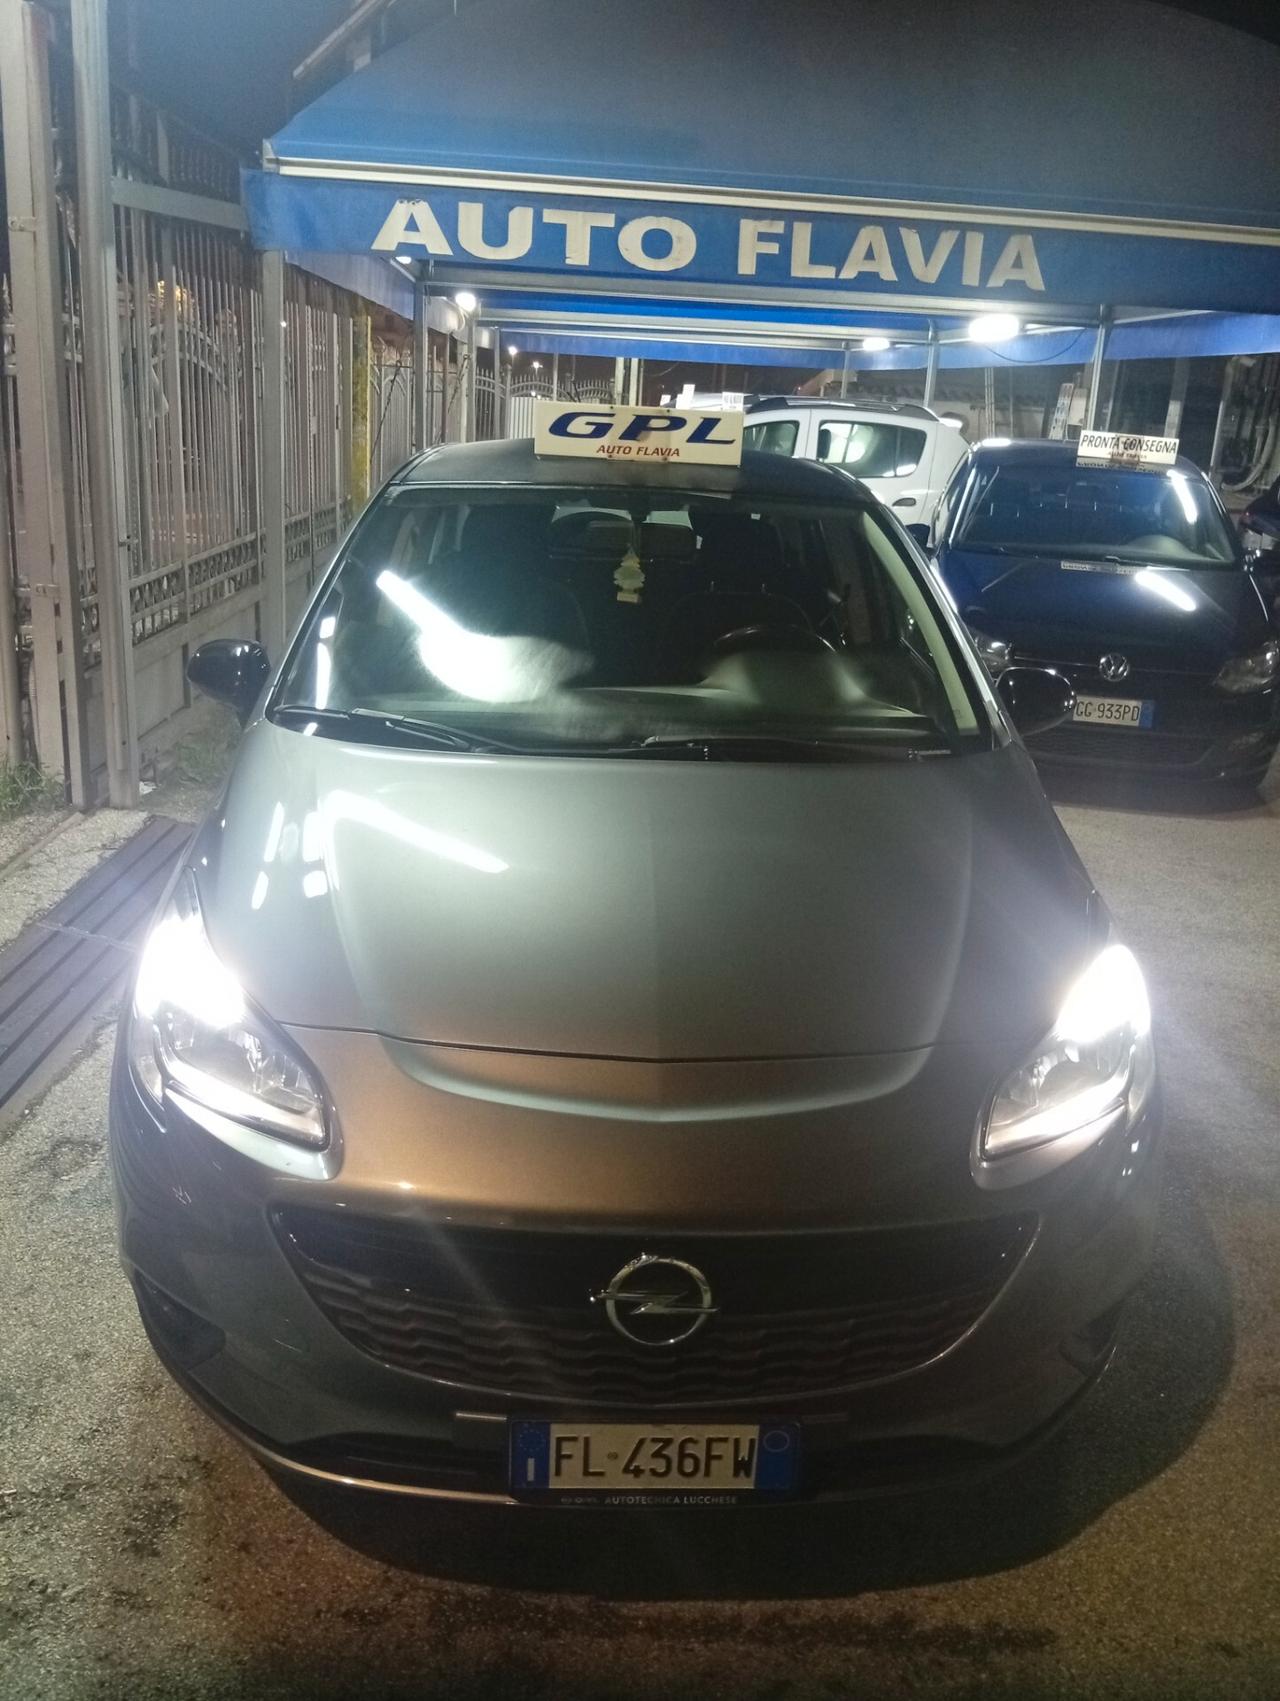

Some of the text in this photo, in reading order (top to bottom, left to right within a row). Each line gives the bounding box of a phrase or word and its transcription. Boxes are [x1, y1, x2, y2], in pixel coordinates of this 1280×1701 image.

[371, 199, 1046, 291] AUTO FLAVIA
[549, 411, 736, 444] GPL
[596, 444, 680, 457] AUTO FLAVIA
[1081, 434, 1177, 454] PRONTA CONSEGNA
[1097, 703, 1140, 721] 933PD
[554, 1436, 756, 1478] FL 436FW
